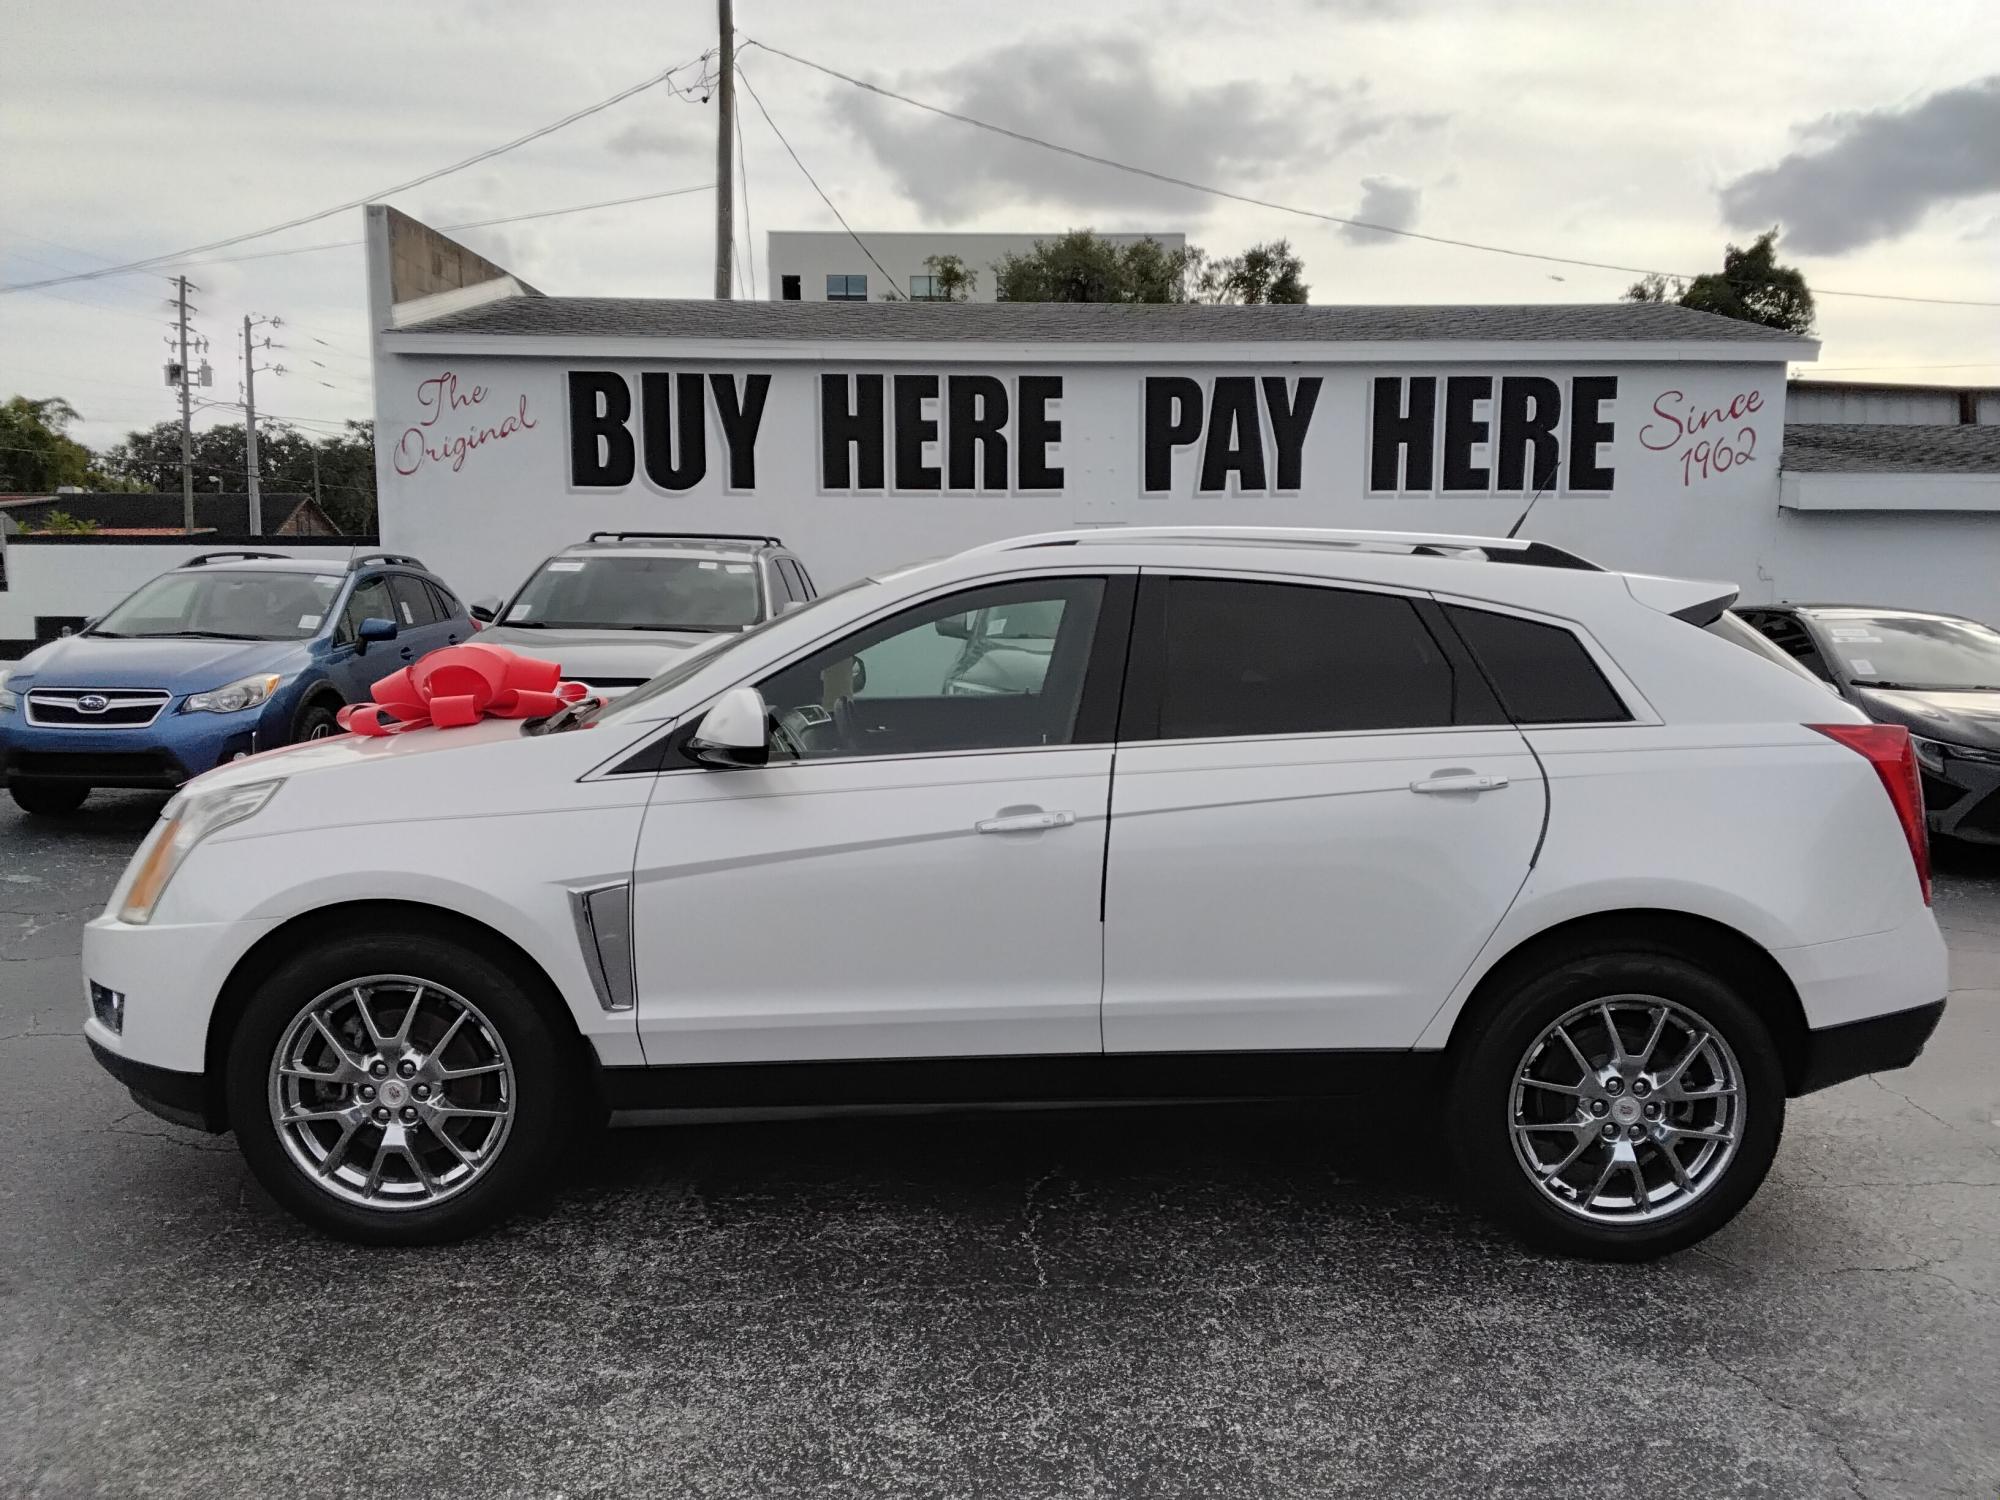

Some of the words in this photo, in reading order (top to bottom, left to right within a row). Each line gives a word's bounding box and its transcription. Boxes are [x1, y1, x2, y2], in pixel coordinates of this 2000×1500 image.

[417, 371, 489, 427] The
[1639, 390, 1765, 451] Since
[393, 394, 538, 476] Original
[567, 370, 772, 491] BUY
[820, 373, 1065, 490] HERE
[1144, 376, 1324, 492] PAY
[1370, 375, 1619, 491] HERE
[1680, 426, 1758, 487] 1962
